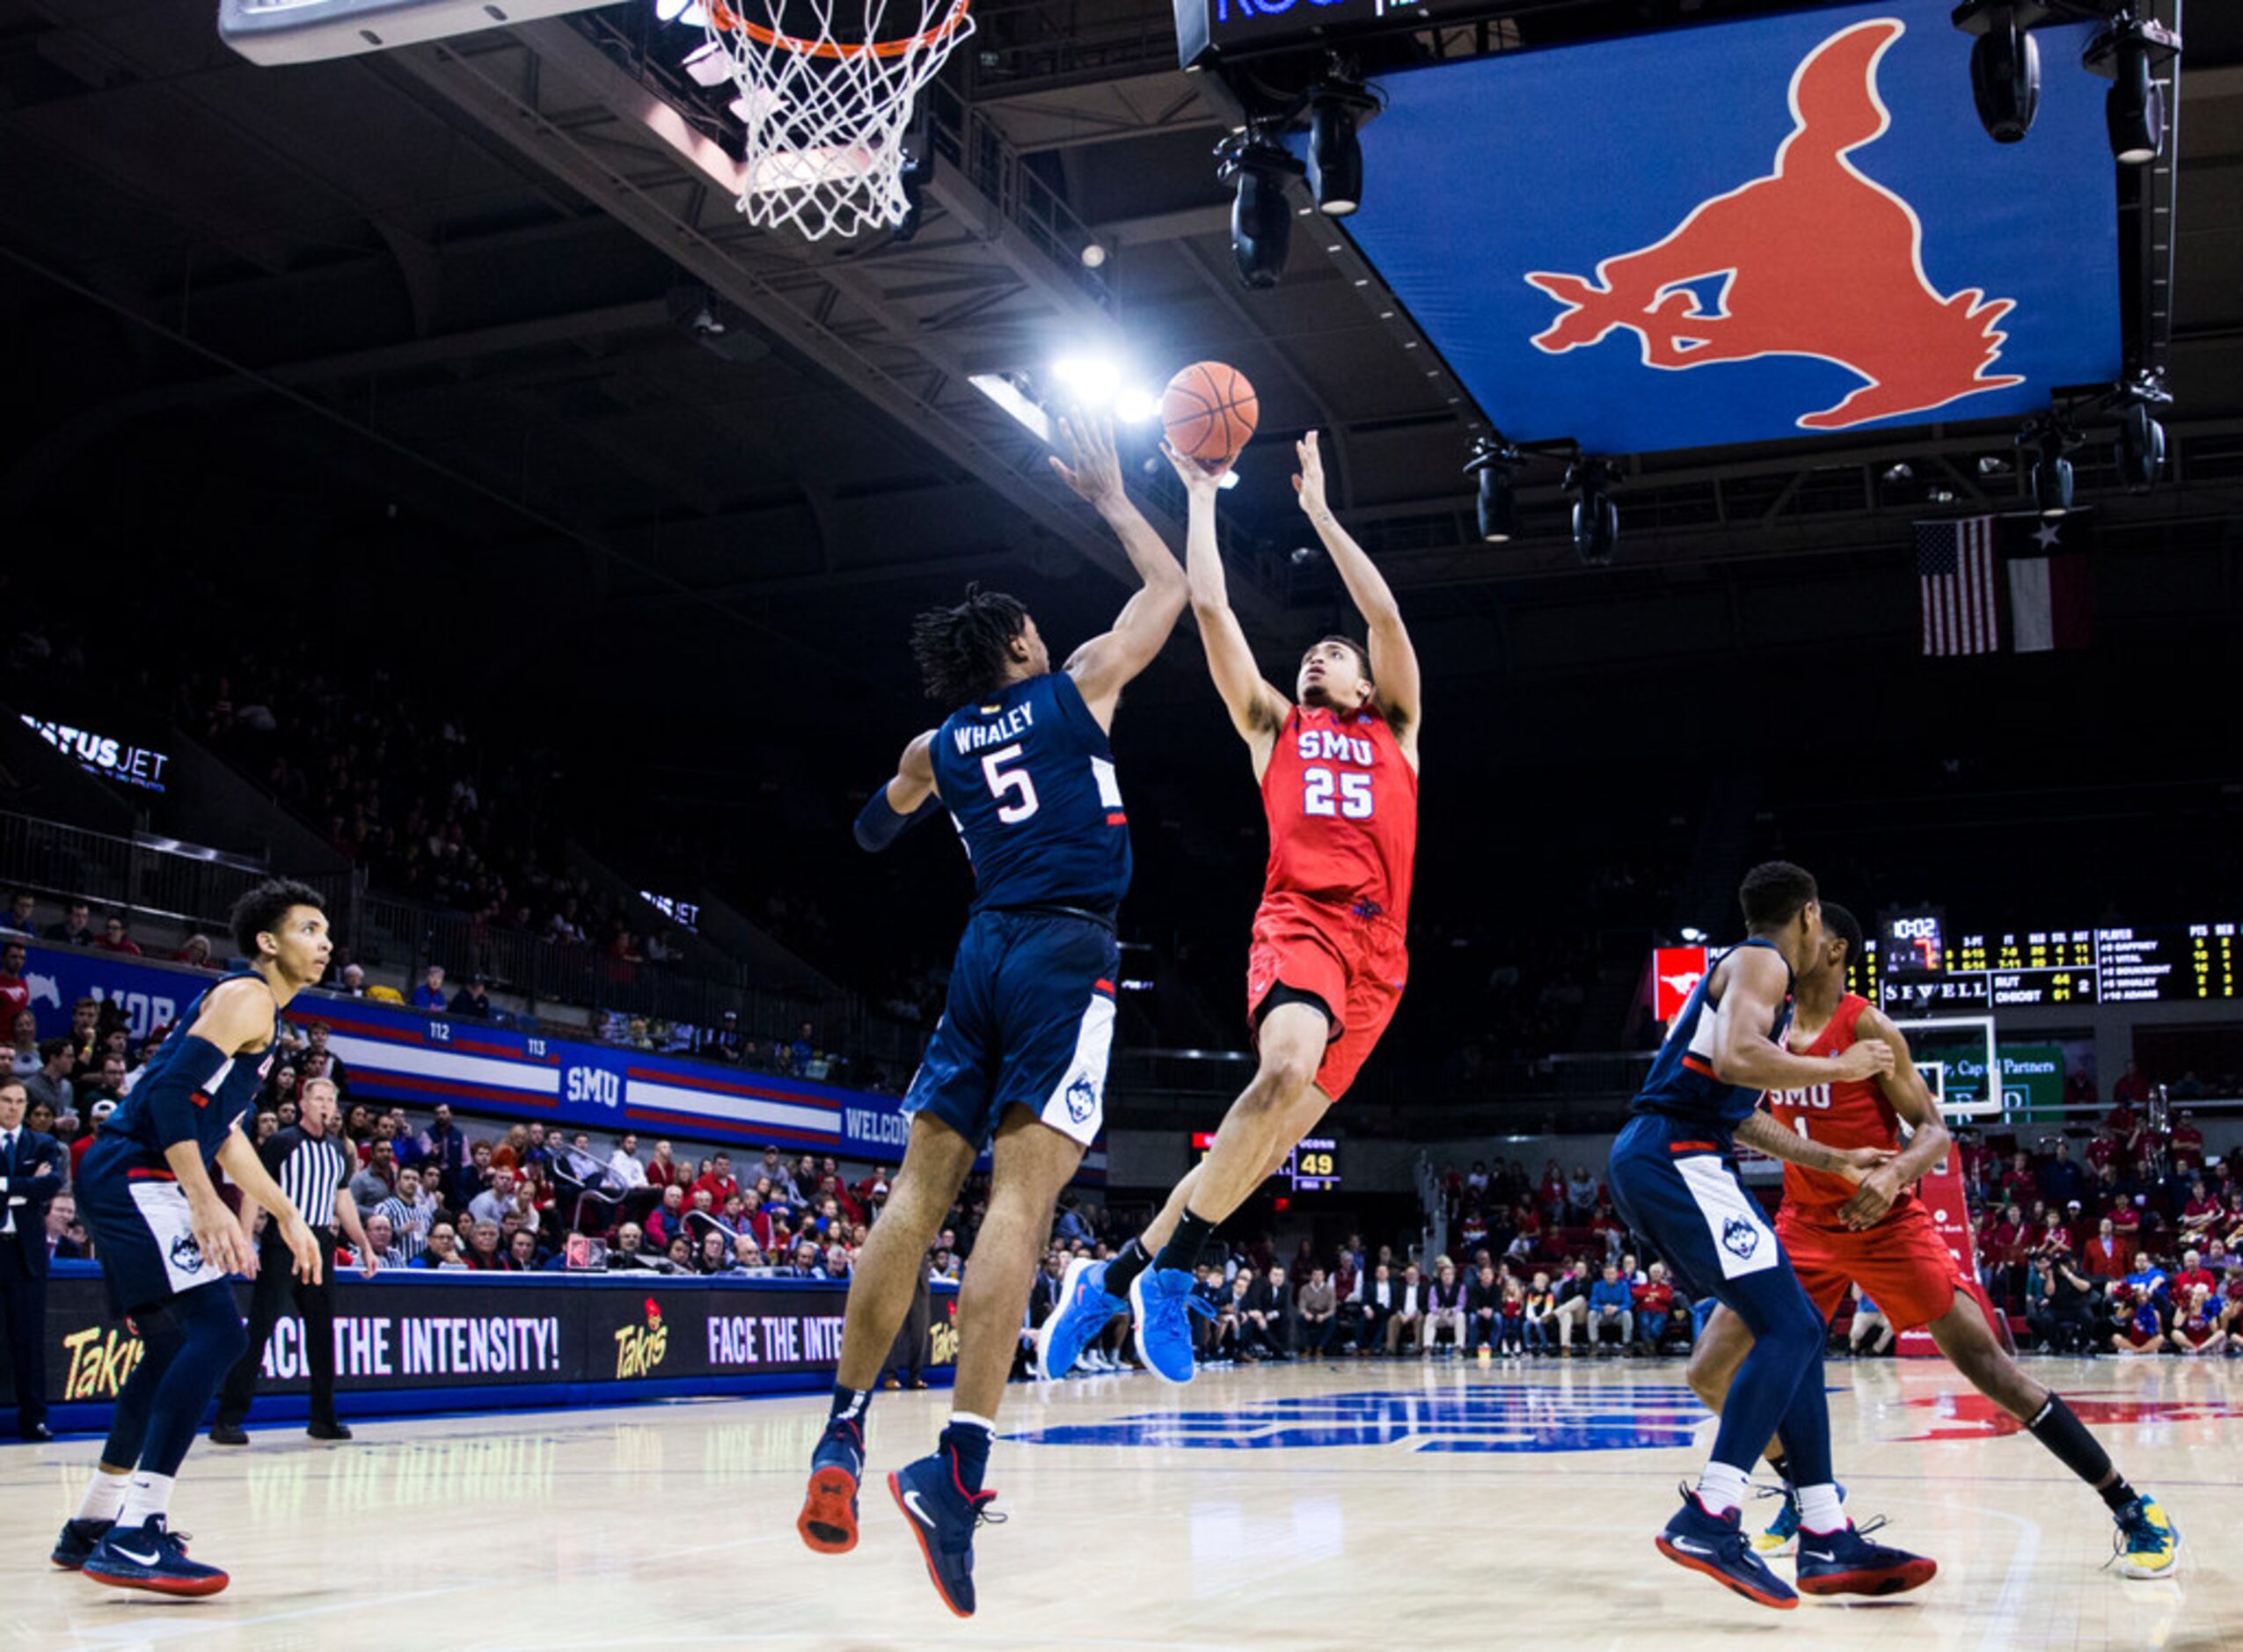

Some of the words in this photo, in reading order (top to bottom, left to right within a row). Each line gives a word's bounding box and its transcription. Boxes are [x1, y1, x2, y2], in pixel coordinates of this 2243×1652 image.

[954, 701, 1034, 755] WHALEY
[1298, 729, 1373, 766] SMU
[981, 743, 1040, 824] 5
[1304, 766, 1374, 820] 25
[1893, 917, 1936, 939] 10:02
[1995, 975, 2020, 988] RUT
[2052, 973, 2071, 985] 44
[430, 1021, 450, 1041] 112
[528, 1038, 547, 1056] 113
[2004, 1058, 2056, 1075] Partners
[567, 1066, 619, 1108] SMU
[1301, 1153, 1333, 1174] 49
[332, 1316, 392, 1376] THE
[401, 1316, 560, 1375] INTENSITY!
[615, 1324, 669, 1379] Takis
[707, 1316, 759, 1364] FACE
[762, 1316, 800, 1363] THE
